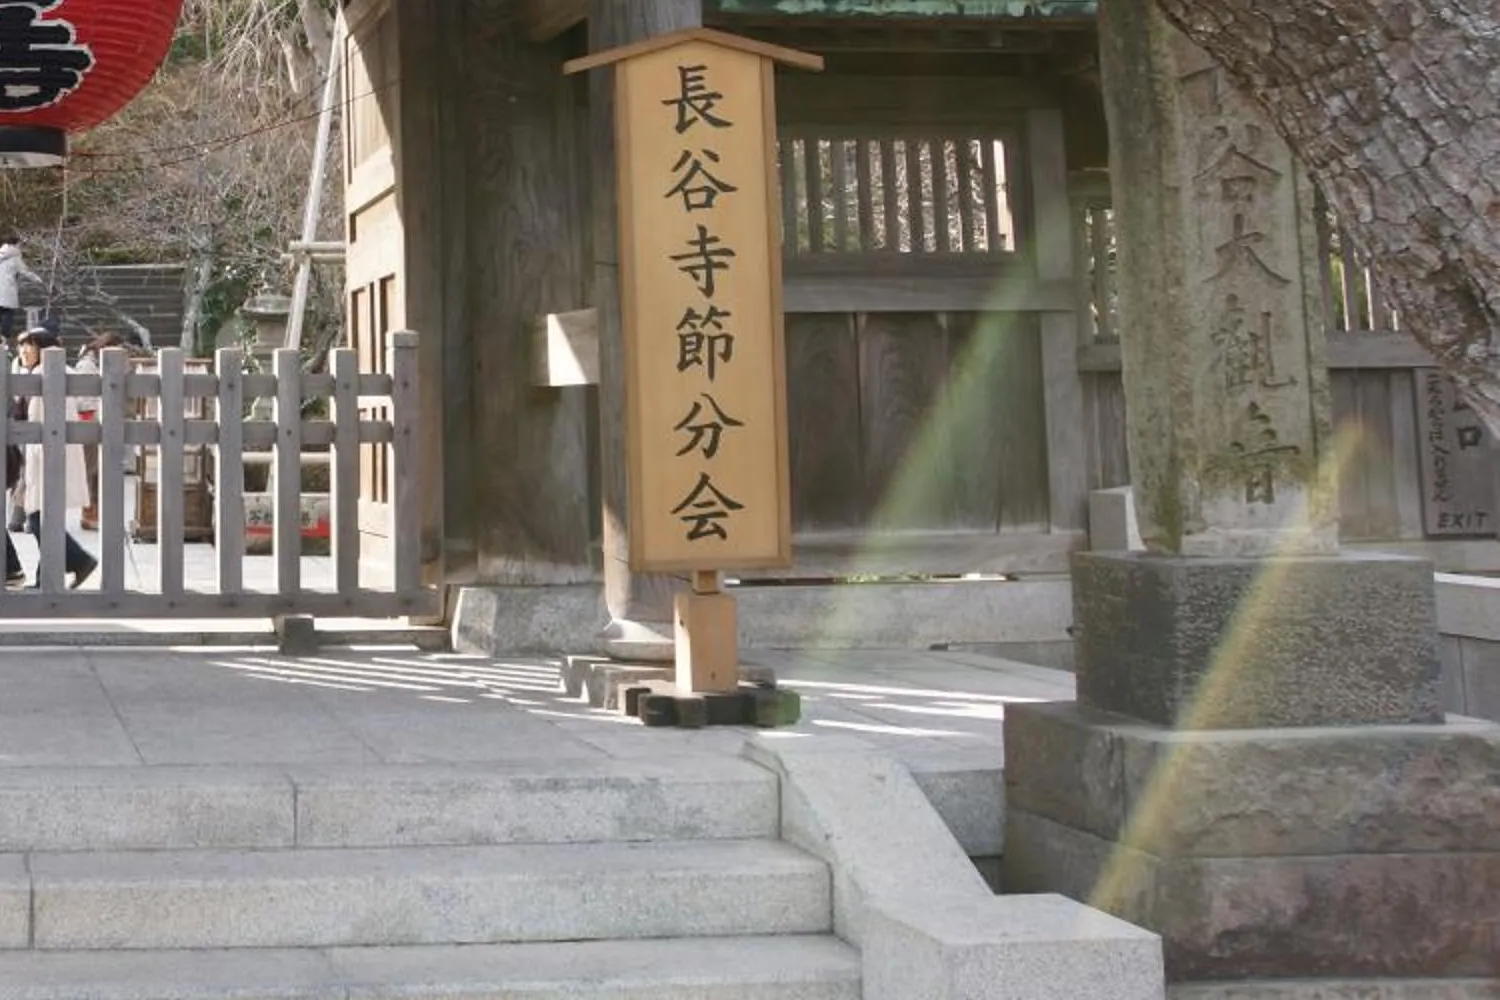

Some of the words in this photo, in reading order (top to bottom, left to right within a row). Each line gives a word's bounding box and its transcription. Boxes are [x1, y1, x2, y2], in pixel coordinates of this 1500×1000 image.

[662, 65, 745, 541] 長谷寺節分会
[1437, 511, 1488, 530] EXIT
